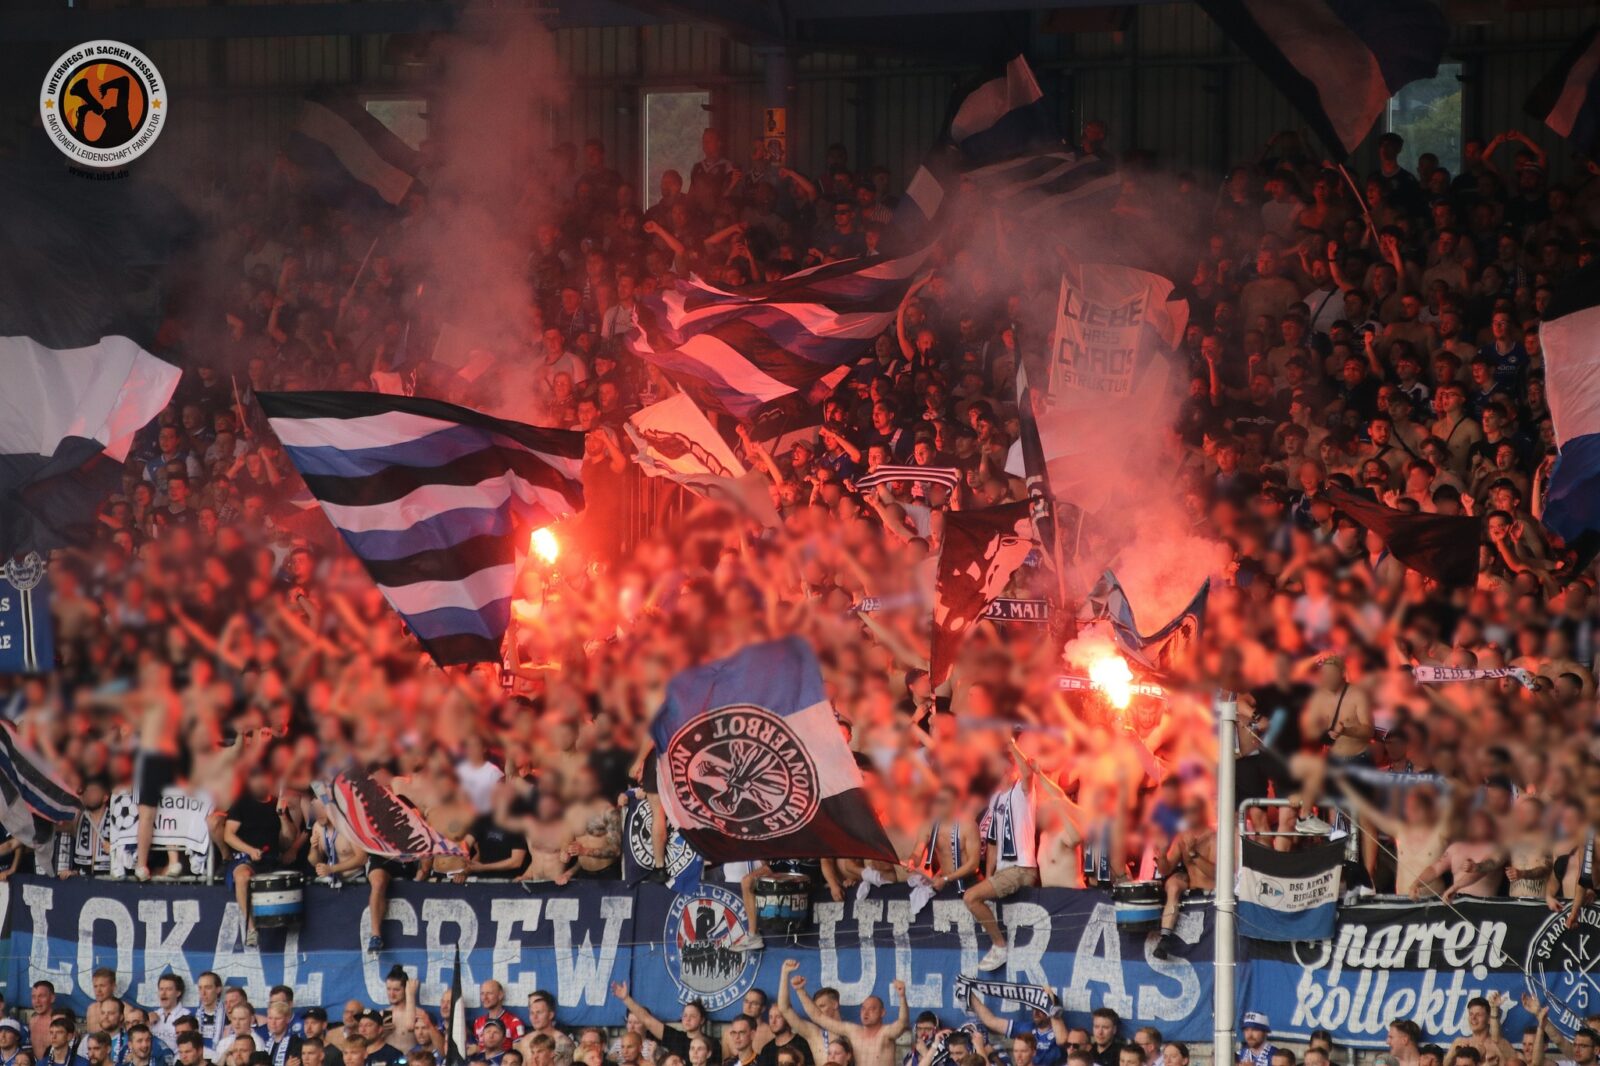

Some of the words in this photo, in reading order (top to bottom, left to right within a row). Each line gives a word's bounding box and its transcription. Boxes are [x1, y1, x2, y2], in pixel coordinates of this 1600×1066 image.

[1063, 288, 1143, 328] LIEBE
[1010, 602, 1039, 619] MAI
[712, 715, 810, 832] STADIONVERBOT
[21, 884, 323, 1007] LOKAL
[360, 896, 633, 1006] CREW
[813, 900, 1205, 1021] ULTRAS
[976, 984, 1050, 1009] ARMINIA
